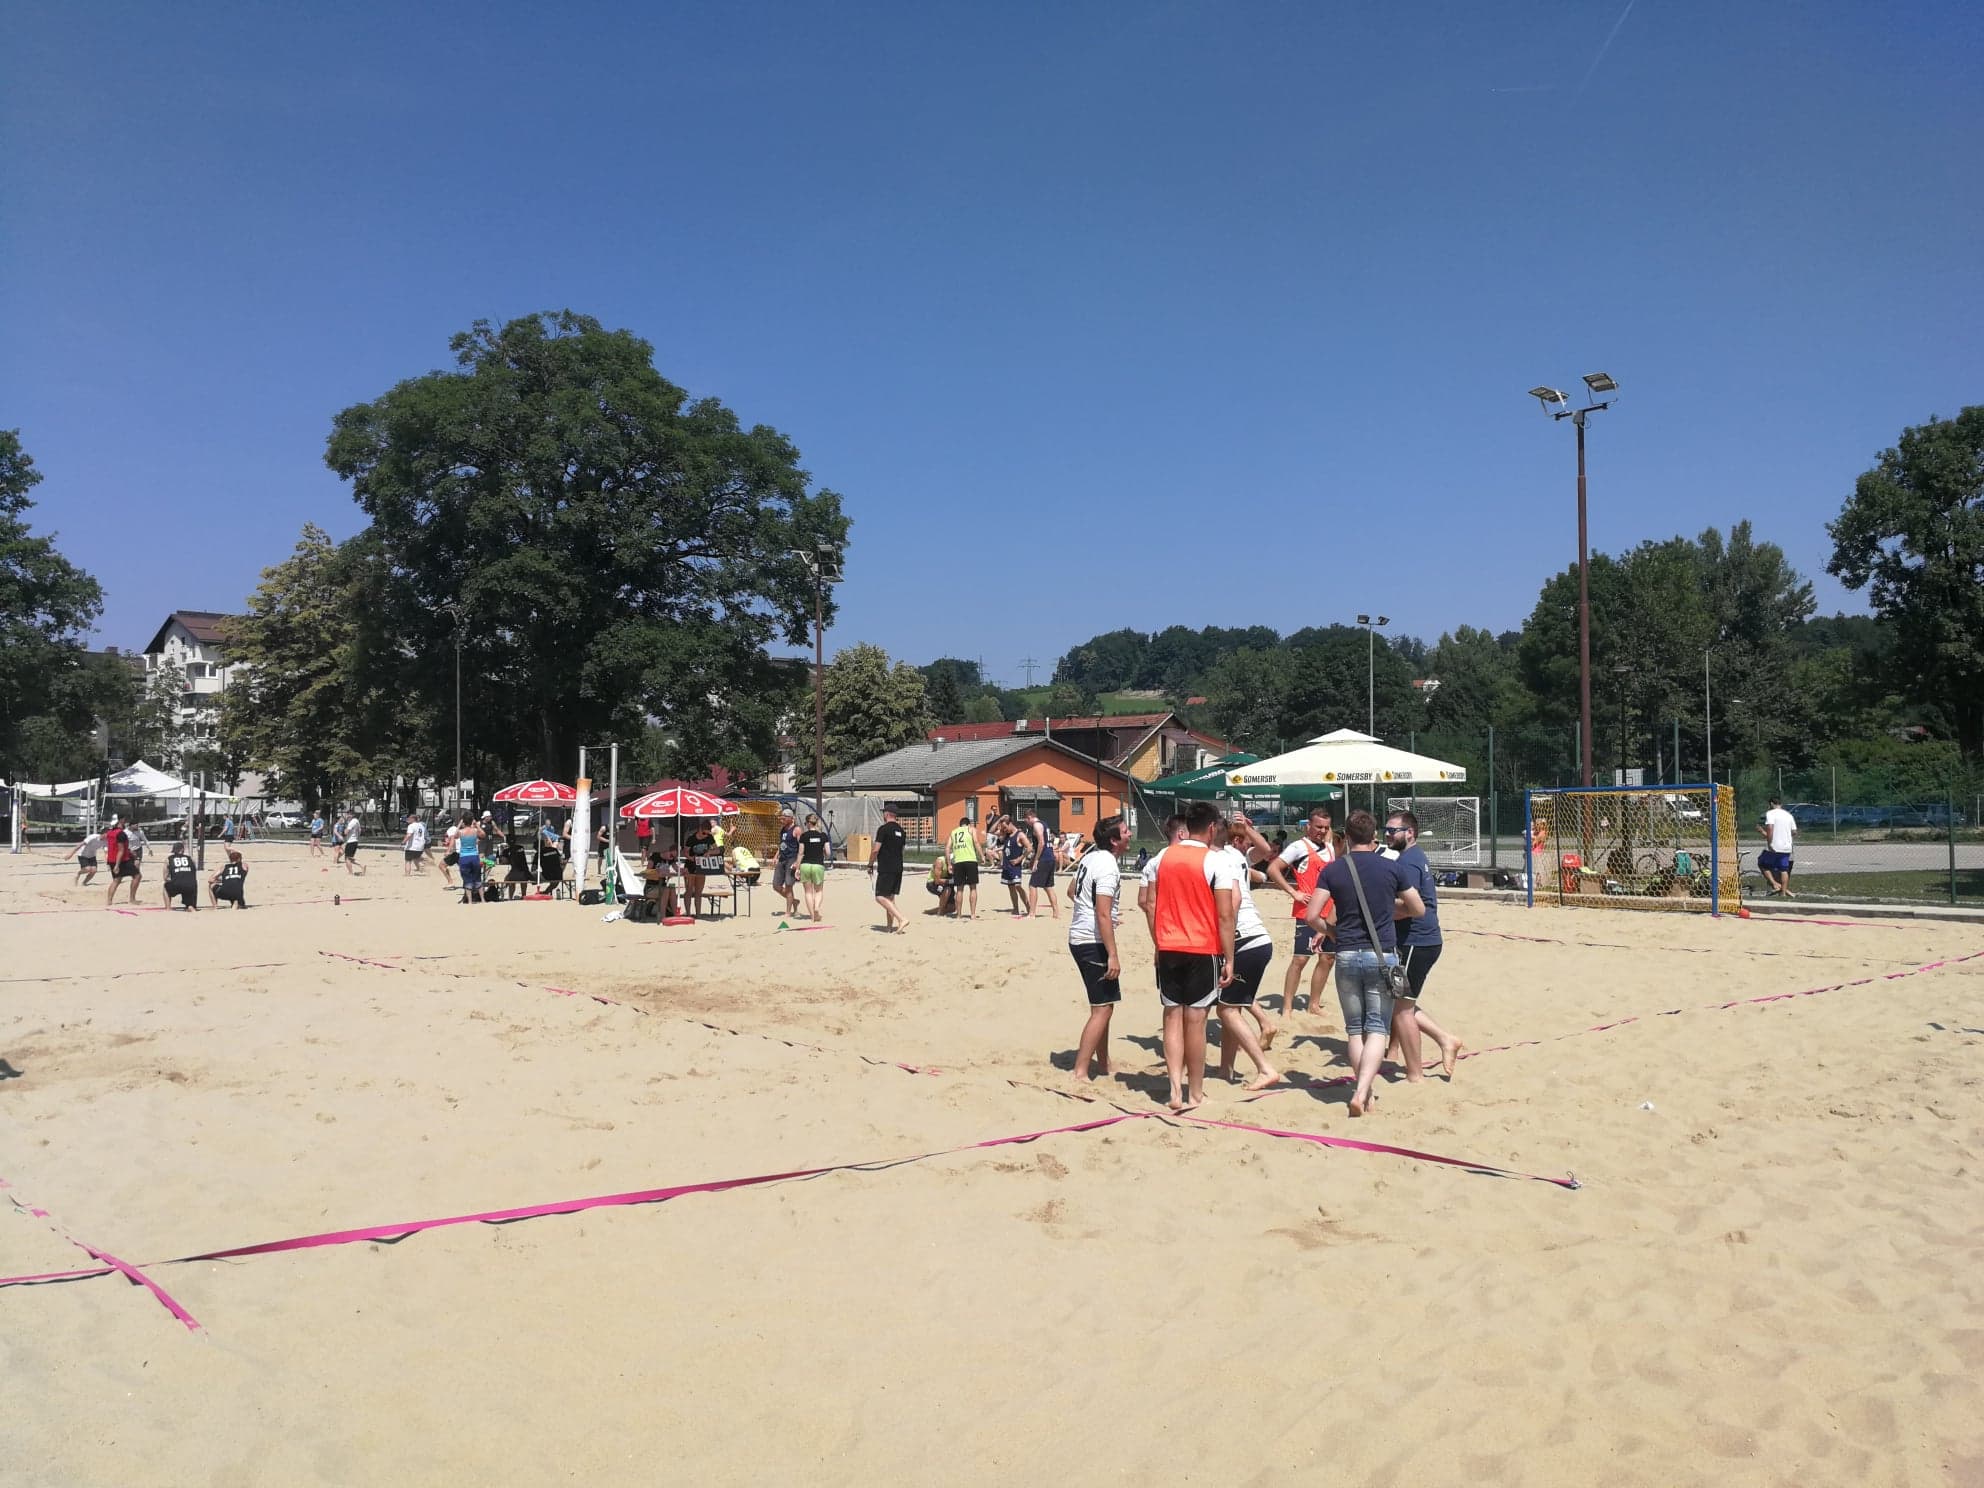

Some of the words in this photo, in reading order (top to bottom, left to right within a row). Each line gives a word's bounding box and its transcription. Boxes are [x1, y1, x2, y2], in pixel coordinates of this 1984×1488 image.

[1243, 775, 1277, 784] SOMERSBY
[1337, 772, 1373, 781] SOMERSBY
[954, 831, 965, 845] 12
[173, 857, 189, 867] 66
